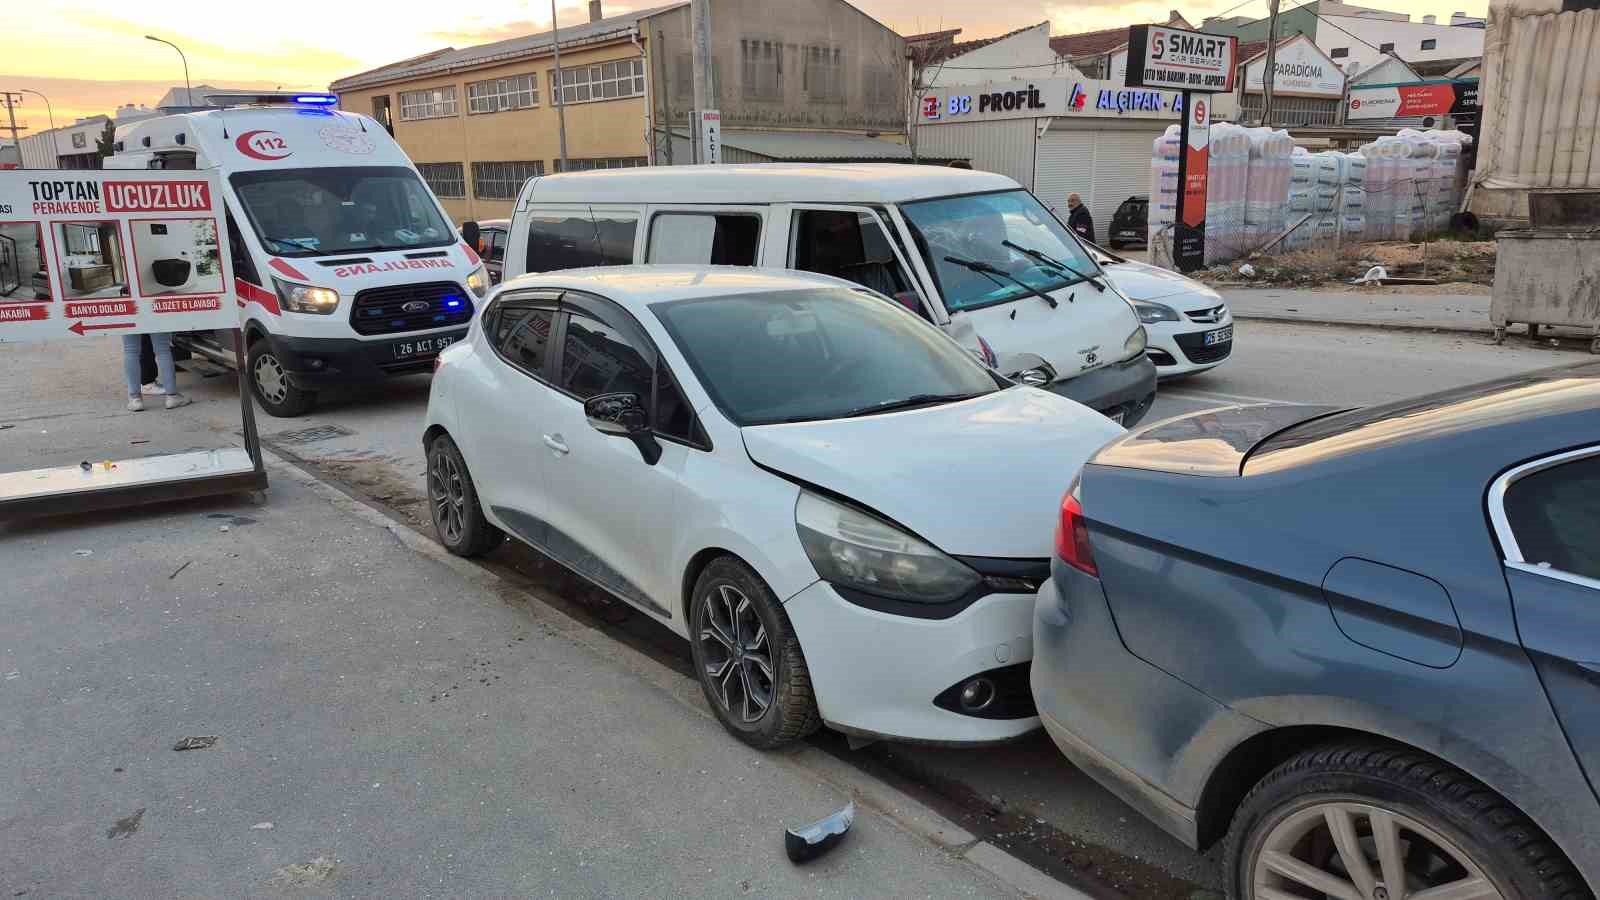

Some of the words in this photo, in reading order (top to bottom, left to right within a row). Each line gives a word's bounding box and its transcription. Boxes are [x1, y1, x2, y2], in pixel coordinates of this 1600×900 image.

[1169, 33, 1226, 58] SMART
[1170, 54, 1187, 64] CAR
[1144, 68, 1156, 81] OTO
[1274, 63, 1322, 80] PARADIGMA
[949, 95, 972, 116] BC
[979, 84, 1046, 113] PROFİL
[1096, 89, 1161, 115] ALÇIPAN
[1171, 93, 1183, 112] A
[255, 136, 288, 152] 112
[28, 180, 100, 201] TOPTAN
[107, 183, 207, 210] UCUZLUK
[32, 201, 101, 215] PERAKENDE
[71, 305, 98, 317] BANYO
[98, 304, 127, 315] DOLABI
[189, 298, 216, 309] LAVABO
[400, 343, 413, 354] 26
[417, 339, 432, 353] ACT
